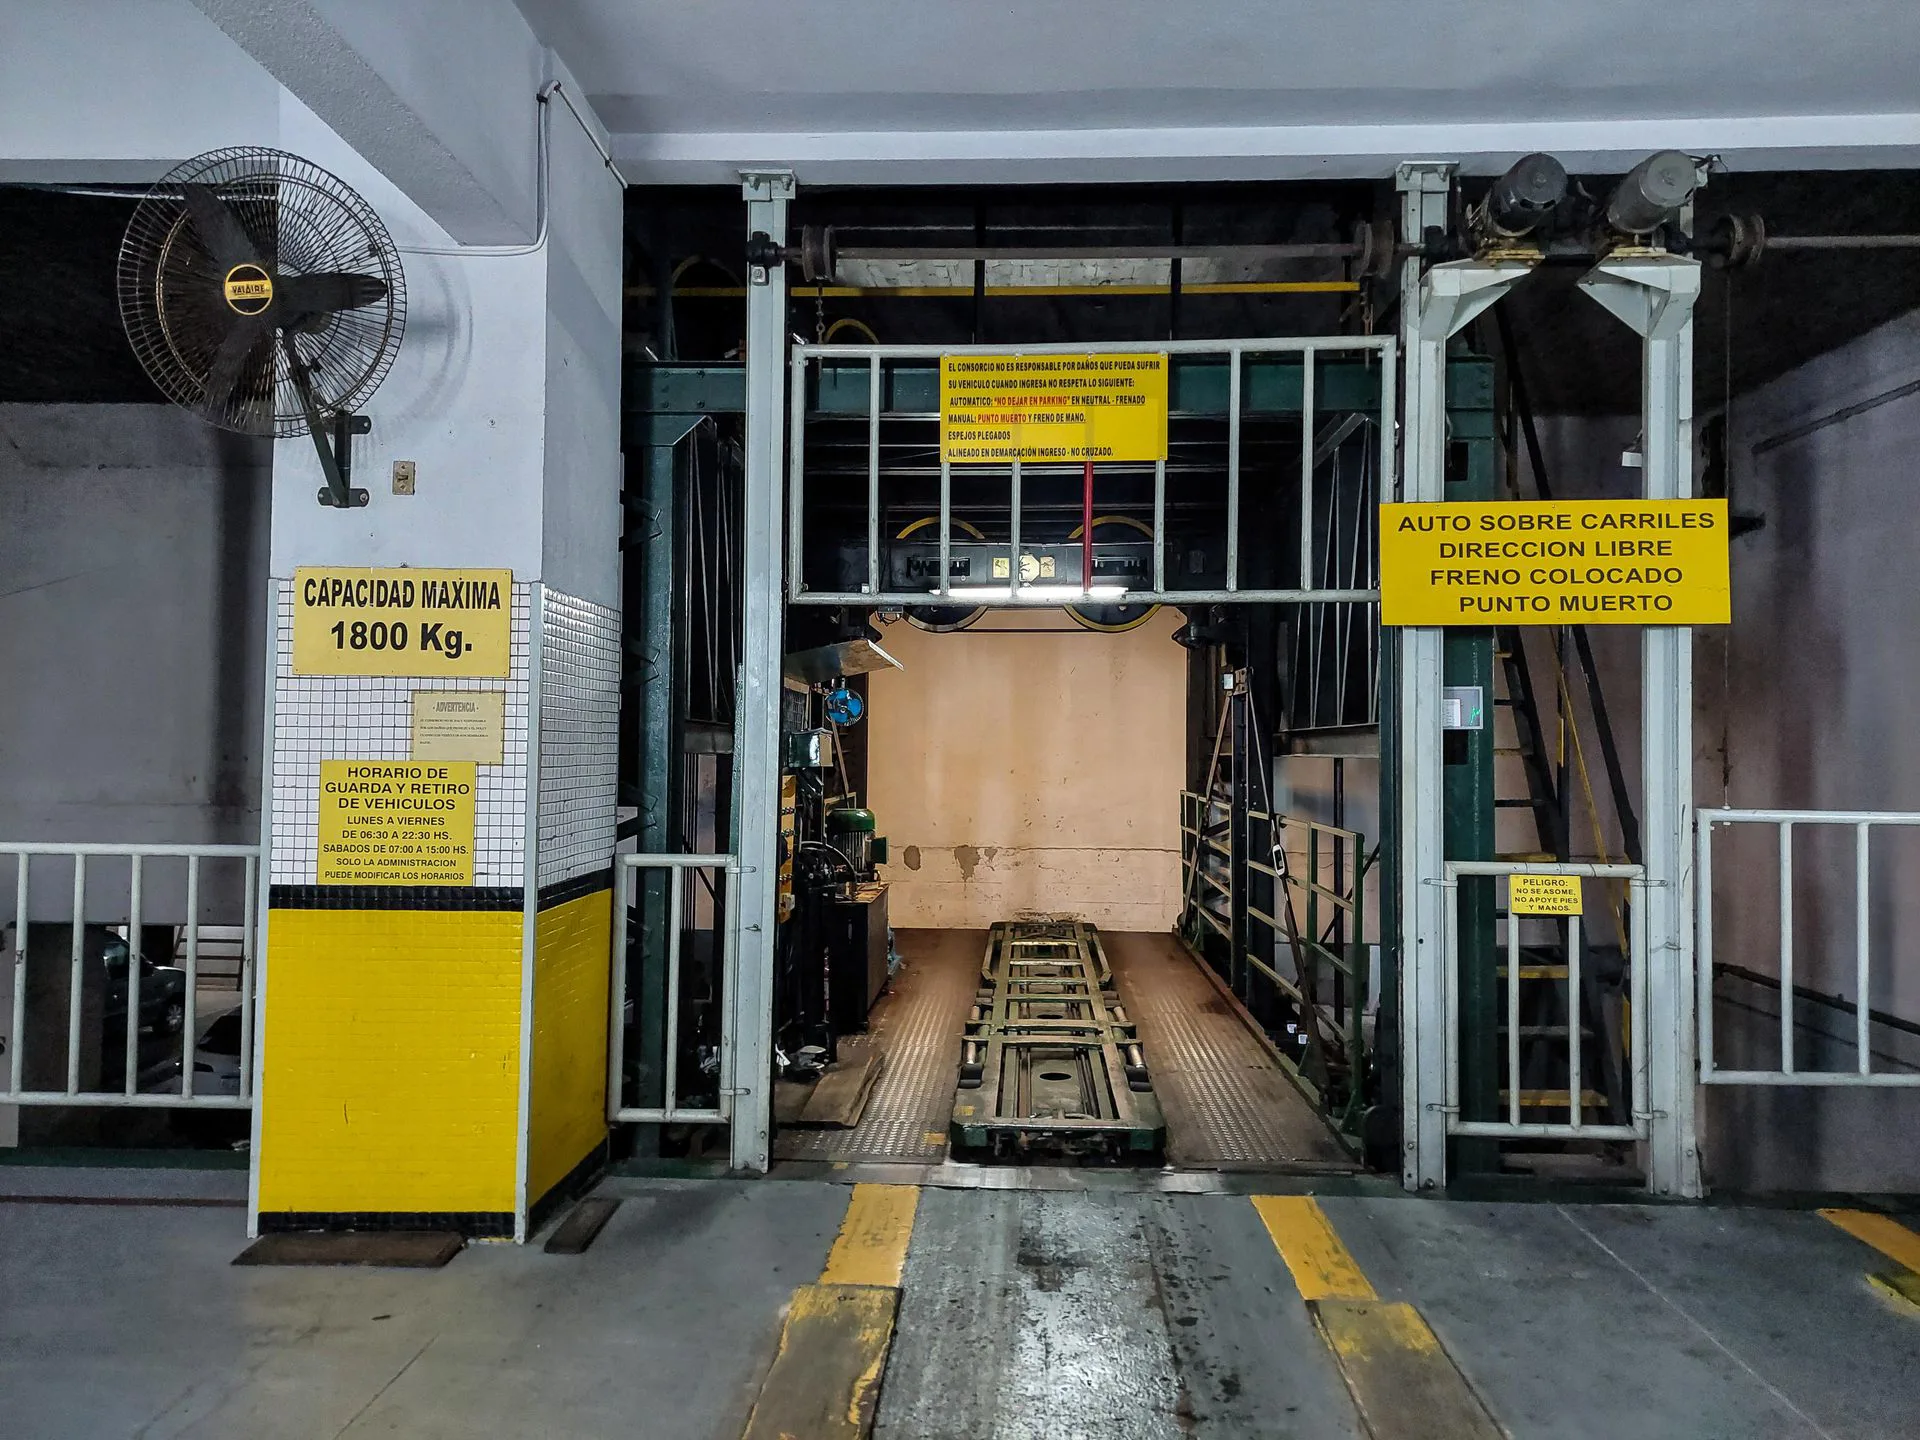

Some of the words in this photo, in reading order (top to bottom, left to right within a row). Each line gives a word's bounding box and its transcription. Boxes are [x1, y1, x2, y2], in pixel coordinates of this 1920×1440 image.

[949, 363, 956, 372] EL
[957, 363, 995, 372] CONSORCIO
[996, 363, 1005, 372] NO
[1006, 362, 1014, 372] ES
[1016, 362, 1061, 372] RESPONSABLE
[1062, 362, 1076, 371] POR
[1077, 360, 1099, 371] DAÑOS
[1100, 361, 1113, 370] QUE
[1114, 361, 1135, 370] PUEDA
[1137, 361, 1161, 370] SUFRIR
[948, 380, 957, 389] SU
[958, 380, 990, 389] VEHICULO
[991, 380, 1018, 389] CUANDO
[1019, 379, 1047, 388] INGRESA
[1048, 379, 1058, 388] NO
[1059, 379, 1087, 388] RESPETA
[1088, 379, 1097, 388] LO
[1098, 378, 1135, 388] SIGUIENTE:
[950, 397, 993, 406] AUTOMATICO:
[1008, 397, 1028, 406] DEJAR
[1029, 396, 1038, 405] EN
[1071, 396, 1080, 405] EN
[1081, 395, 1111, 405] NEUTRAL
[1115, 395, 1146, 404] FRENADO
[948, 414, 977, 424] MANUAL:
[978, 414, 1000, 423] PUNTO
[1001, 414, 1027, 423] MUERTO
[1027, 413, 1032, 423] Y
[1034, 413, 1055, 422] FRENO
[1056, 413, 1064, 422] DE
[1065, 413, 1086, 422] MANO.
[948, 431, 977, 440] ESPEJOS
[978, 431, 1011, 440] PLEGADOS
[948, 448, 980, 457] ALINEADO
[981, 448, 989, 457] EN
[991, 446, 1036, 457] DEMARCACIÓN
[1038, 447, 1066, 457] INGRESO
[1071, 447, 1080, 456] NO
[1081, 447, 1114, 456] CRUZADO.
[1398, 515, 1472, 532] AUTO
[1479, 514, 1572, 531] SOBRE
[1580, 512, 1715, 530] CARRILES
[1439, 541, 1586, 559] DIRECCION
[1595, 540, 1673, 557] LIBRE
[1430, 569, 1521, 586] FRENO
[1529, 567, 1683, 585] COLOCADO
[304, 578, 415, 608] CAPACIDAD
[421, 580, 501, 610] MAXIMA
[1459, 595, 1551, 612] PUNTO
[1559, 594, 1673, 611] MUERTO
[331, 620, 408, 650] 1800
[420, 623, 472, 659] Kg.
[347, 767, 422, 779] HORARIO
[427, 768, 448, 779] DE
[325, 782, 392, 794] GUARDA
[395, 783, 406, 794] Y
[411, 783, 470, 795] RETIRO
[338, 798, 360, 809] DE
[364, 798, 456, 810] VEHICULOS
[347, 816, 383, 825] LUNES
[386, 817, 394, 825] A
[397, 817, 445, 826] VIERNES
[342, 830, 357, 839] DE
[360, 830, 388, 839] 06:30
[391, 831, 399, 839] A
[402, 831, 430, 840] 22:30
[433, 832, 452, 840] HS.
[323, 844, 371, 853] SABADOS
[373, 845, 386, 853] DE
[388, 845, 414, 854] 07:00
[415, 846, 423, 854] A
[426, 846, 450, 854] 15:00
[452, 846, 469, 854] HS.
[336, 858, 361, 866] SOLO
[363, 858, 375, 866] LA
[377, 858, 457, 867] ADMINISTRACION
[325, 871, 353, 879] PUEDE
[354, 872, 400, 880] MODIFICAR
[402, 872, 419, 880] LOS
[420, 872, 465, 880] HORARIOS
[1523, 879, 1568, 887] PELIGRO:
